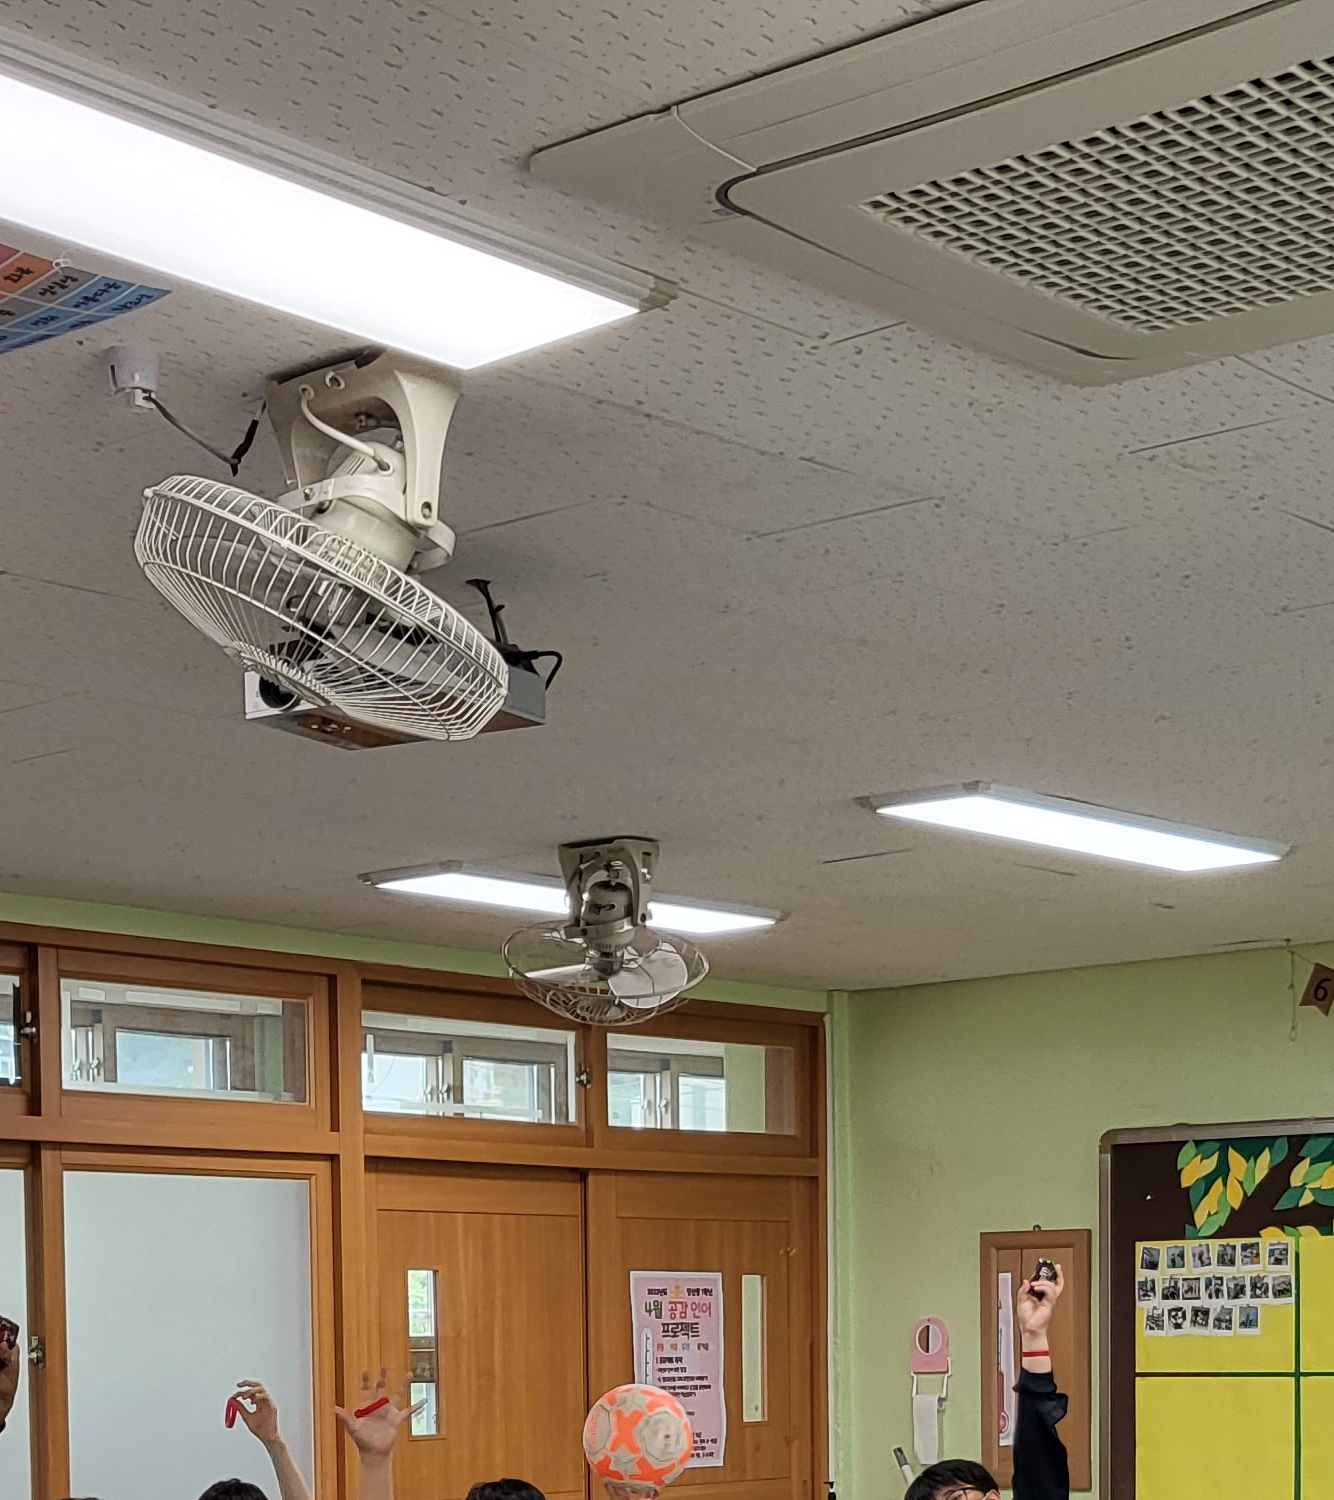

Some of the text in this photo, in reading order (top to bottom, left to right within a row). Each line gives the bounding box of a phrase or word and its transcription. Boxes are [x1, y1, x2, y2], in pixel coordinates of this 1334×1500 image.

[72, 281, 121, 308] 아름다움
[645, 1300, 711, 1320] 4월 공감 언어
[661, 1322, 700, 1340] 프로젝트
